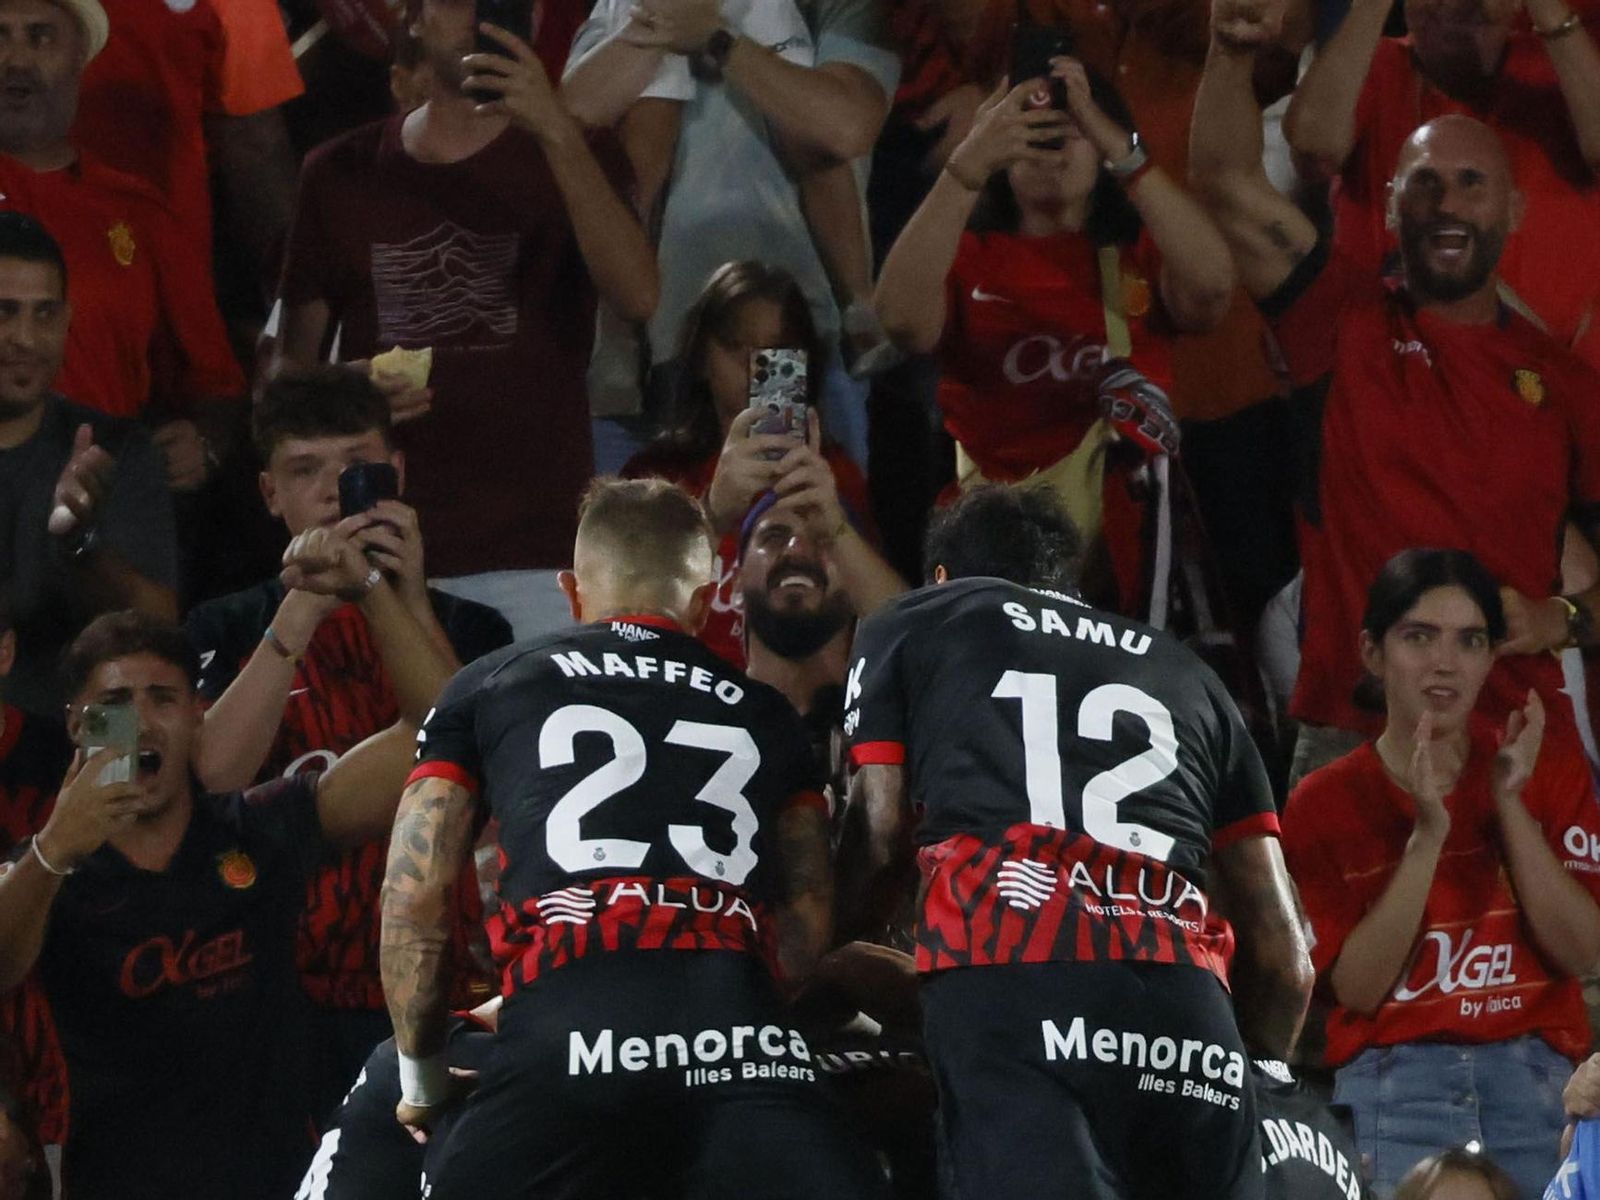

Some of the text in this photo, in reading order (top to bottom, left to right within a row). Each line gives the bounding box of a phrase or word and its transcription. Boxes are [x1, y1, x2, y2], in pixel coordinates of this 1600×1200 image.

[1002, 602, 1152, 655] SAMU
[551, 651, 744, 704] MAFFEO
[990, 670, 1179, 862] 12
[539, 704, 760, 886] 23
[608, 882, 758, 932] ALUA
[1069, 861, 1207, 916] ALUA
[1460, 997, 1483, 1018] by
[568, 1025, 811, 1076] Menorca
[686, 1060, 816, 1087] Illes Balears
[1041, 1016, 1244, 1089] Menorca
[1138, 1073, 1241, 1111] Illes Balears
